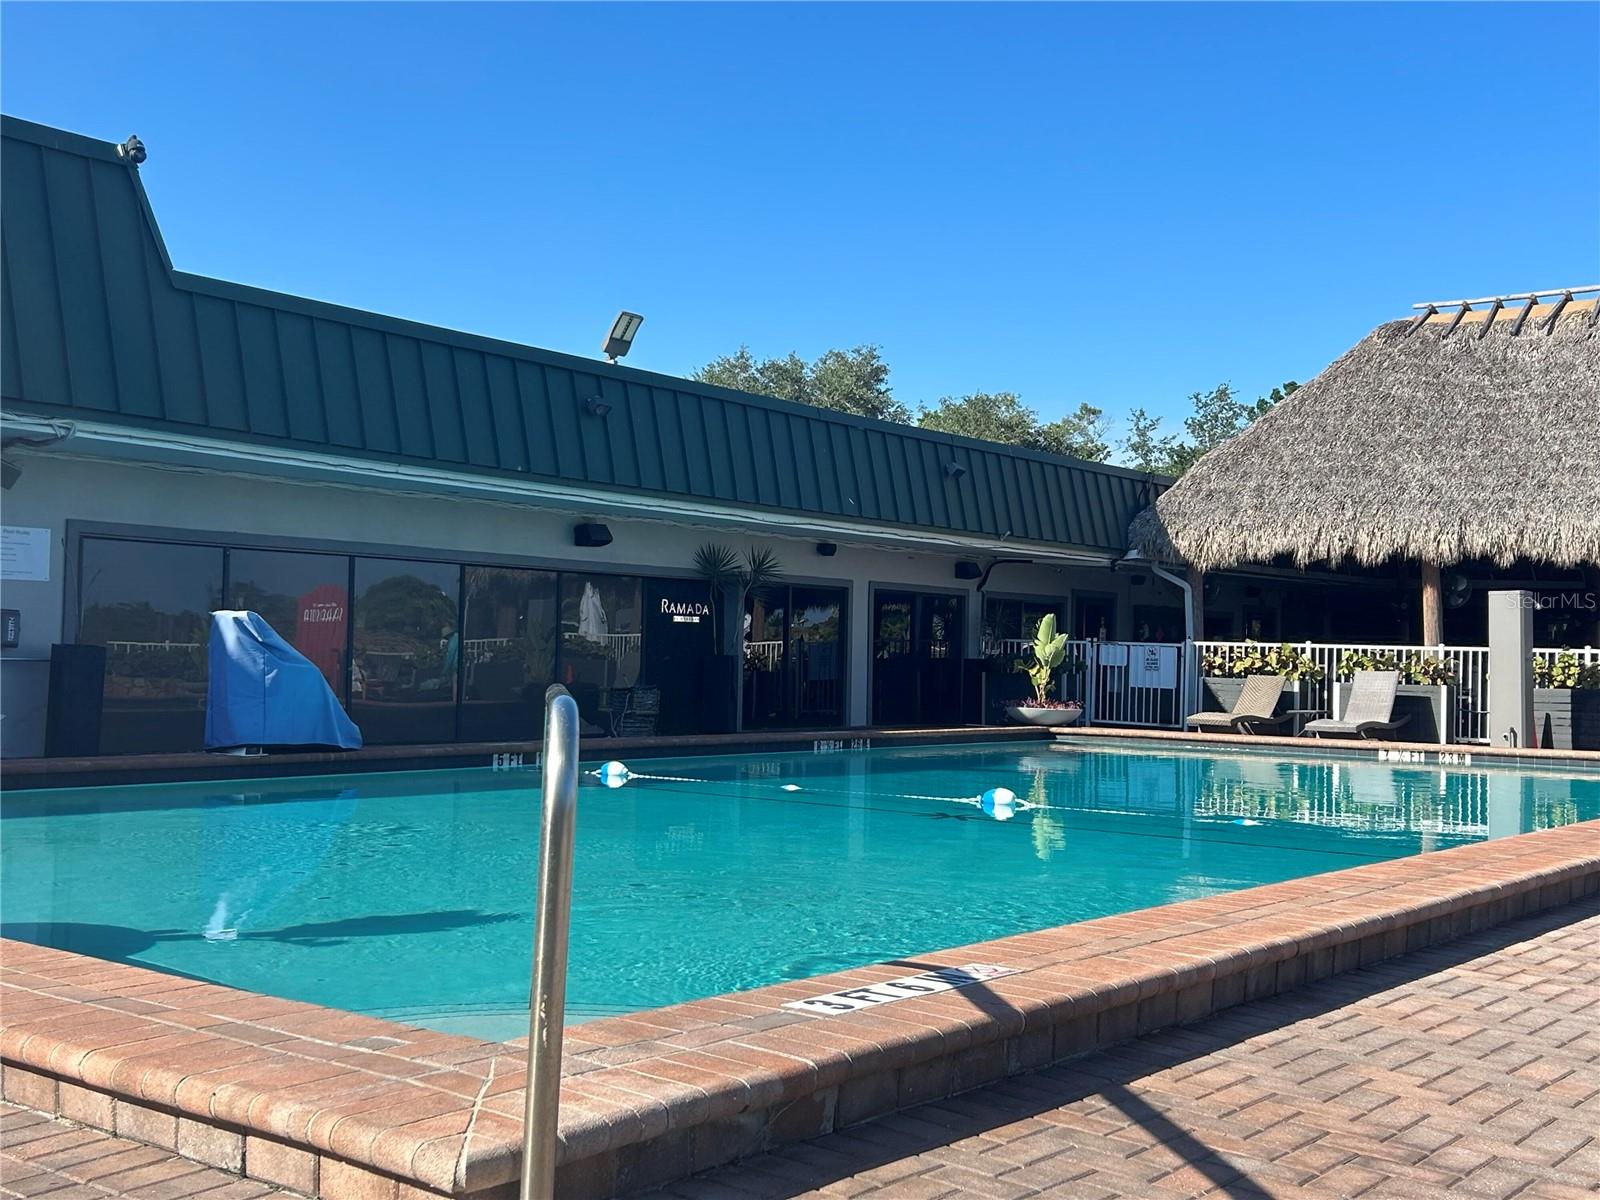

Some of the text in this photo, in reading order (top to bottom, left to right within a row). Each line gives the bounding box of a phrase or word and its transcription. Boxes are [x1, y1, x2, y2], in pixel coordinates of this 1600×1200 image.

[497, 753, 504, 767] 5
[1409, 750, 1424, 763] FT
[1457, 753, 1466, 764] M
[803, 999, 855, 1010] 3
[834, 987, 904, 1003] FT
[885, 982, 935, 992] 6
